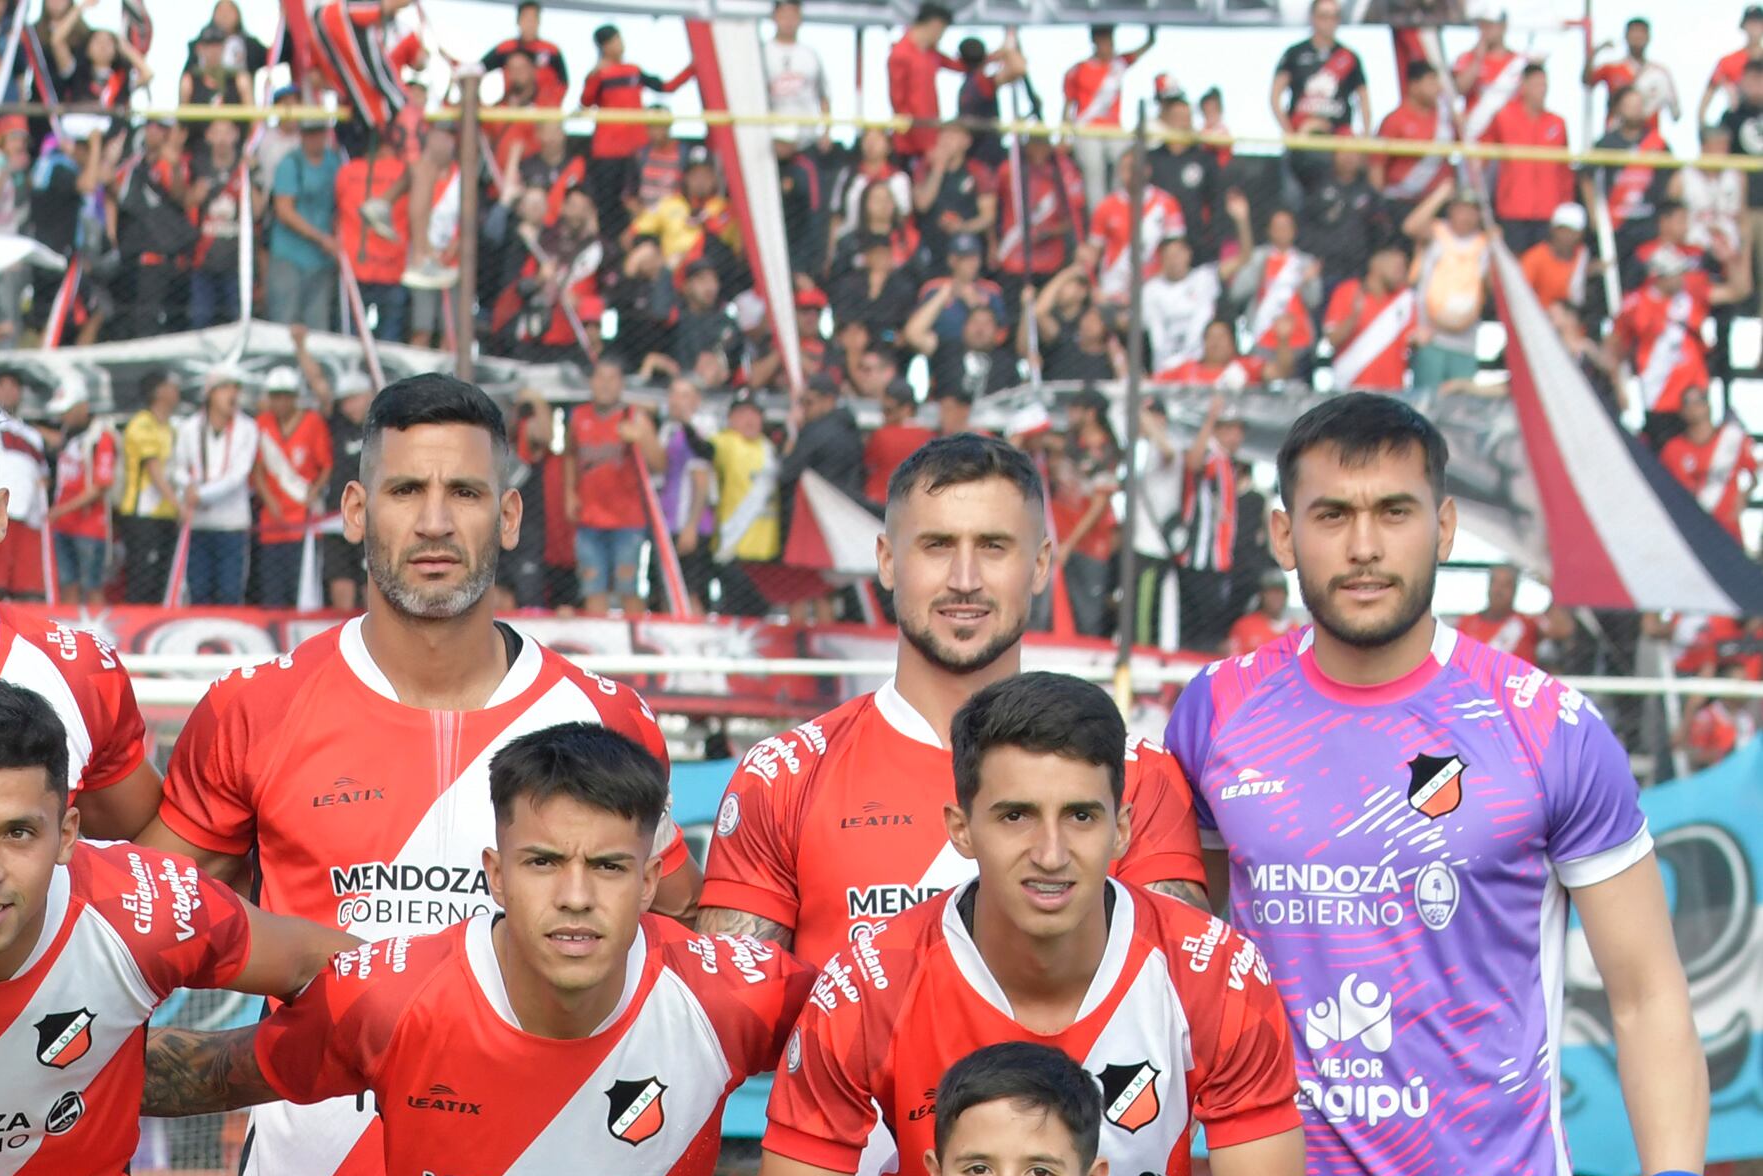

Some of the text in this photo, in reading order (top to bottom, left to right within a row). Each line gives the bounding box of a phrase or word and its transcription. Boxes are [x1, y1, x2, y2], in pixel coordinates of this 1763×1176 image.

[312, 788, 385, 808] LEATIX
[1220, 778, 1285, 800] LEATIX
[840, 814, 913, 829] LEATIX
[1246, 864, 1401, 893] MENDOZA
[1251, 899, 1404, 927] GOBIERNO
[48, 1022, 84, 1057] CDM
[1313, 1057, 1384, 1079] MEJOR
[407, 1094, 484, 1115] LEATIX
[1114, 1074, 1147, 1113] CDM
[618, 1090, 652, 1128] CDM
